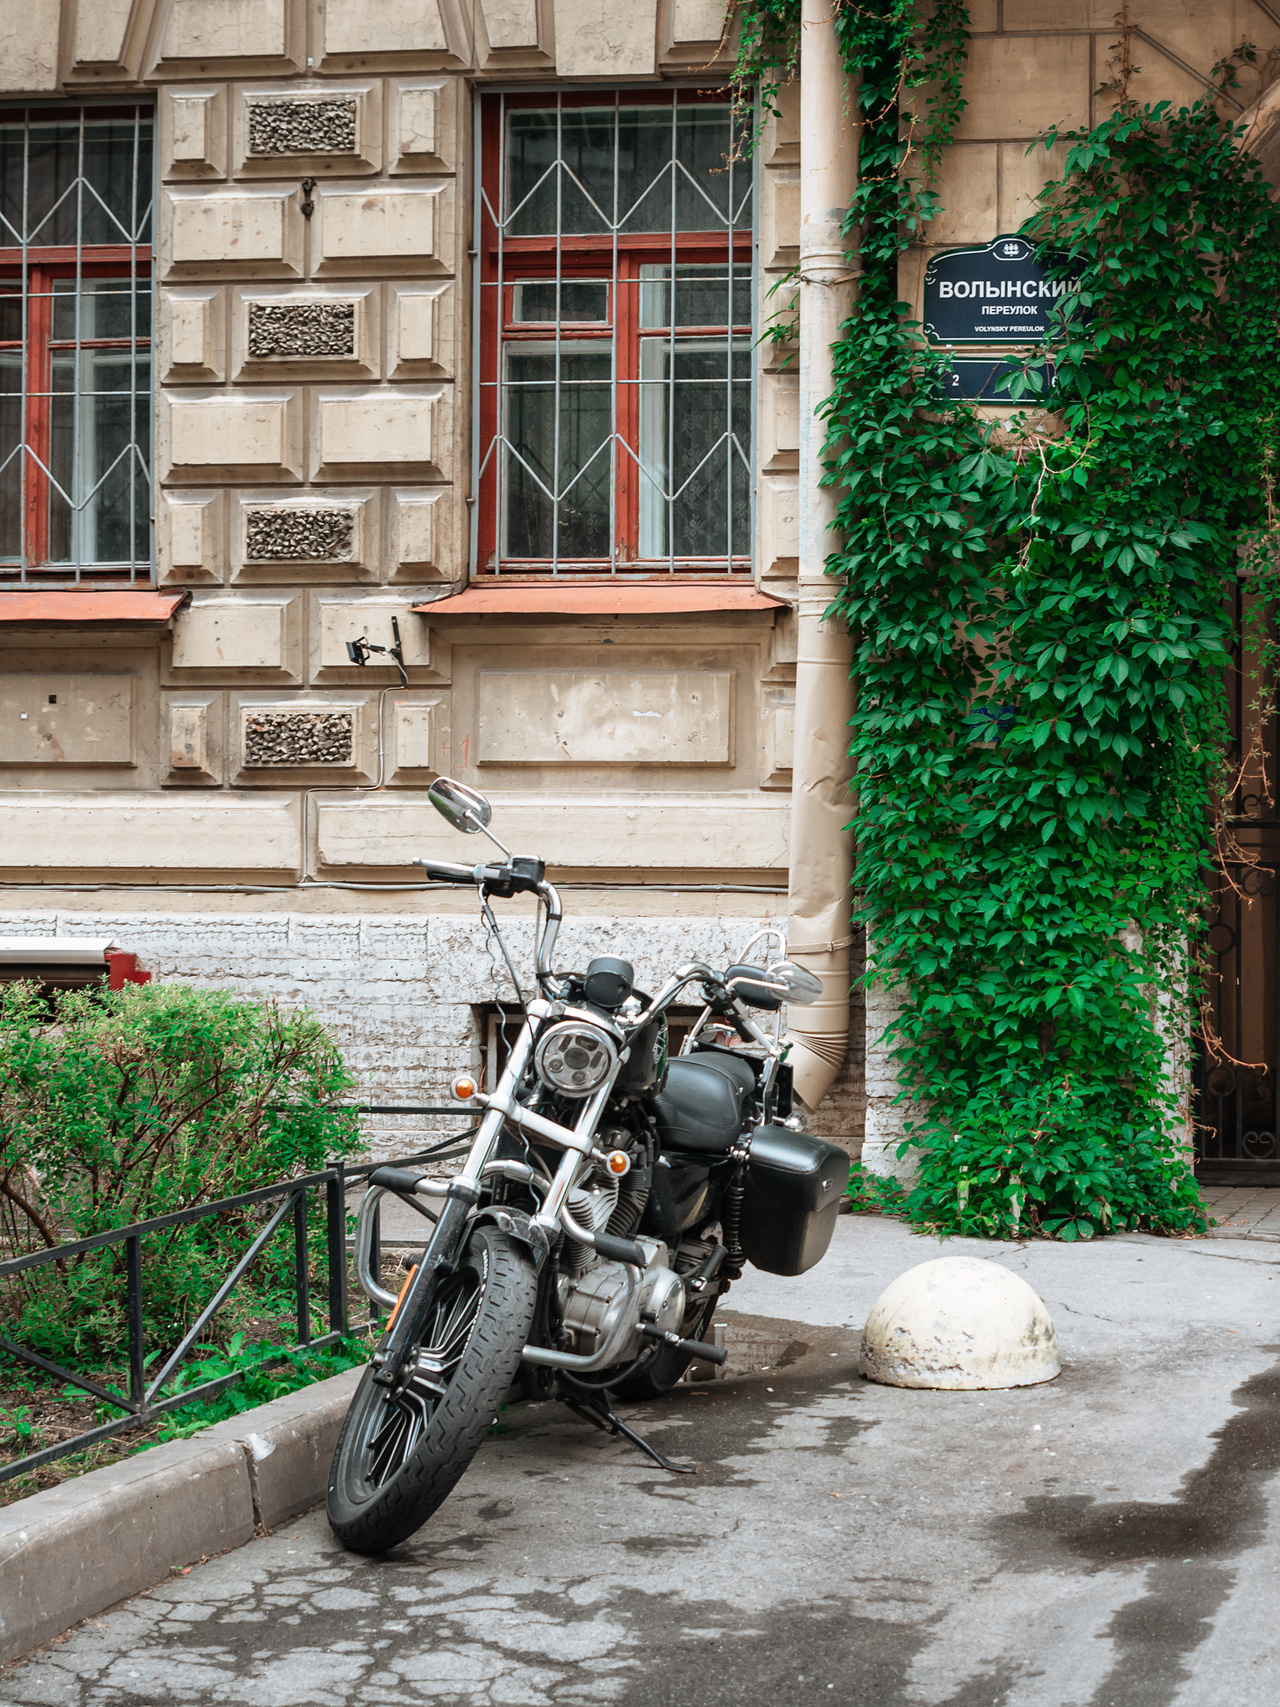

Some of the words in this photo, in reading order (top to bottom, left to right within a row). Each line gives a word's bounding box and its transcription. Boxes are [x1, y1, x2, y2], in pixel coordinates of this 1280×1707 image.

[939, 276, 1082, 299] ВОЛЫНСКИЙ
[981, 305, 1038, 316] ПЕРЕУЛОК
[951, 374, 960, 387] 2
